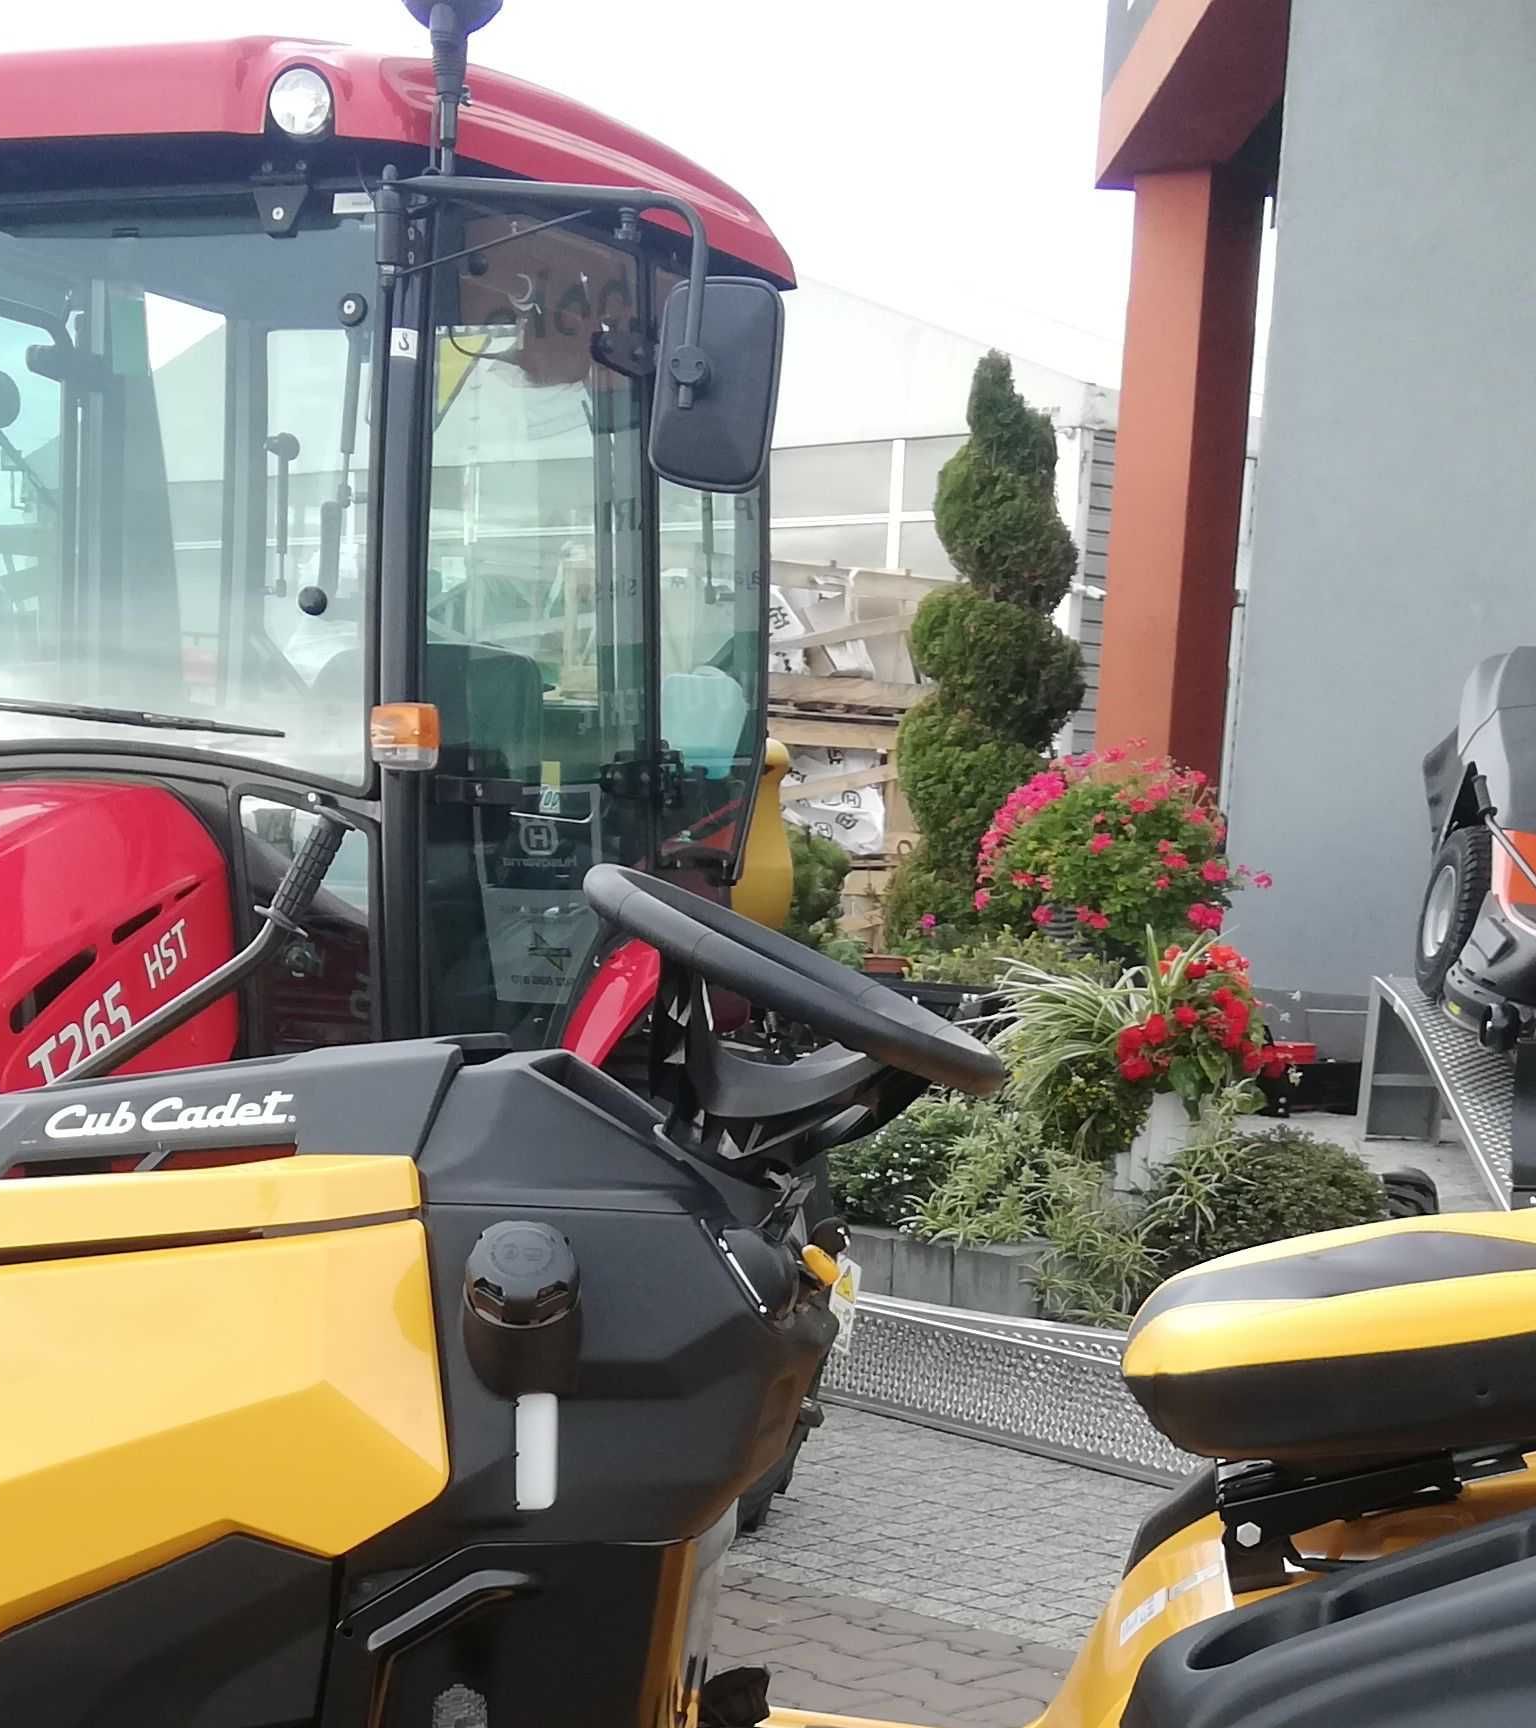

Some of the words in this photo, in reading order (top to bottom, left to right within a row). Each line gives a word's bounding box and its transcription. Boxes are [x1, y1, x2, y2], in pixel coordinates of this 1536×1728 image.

[143, 918, 188, 990] HST
[27, 980, 133, 1087] T265
[44, 1100, 136, 1138] Cub
